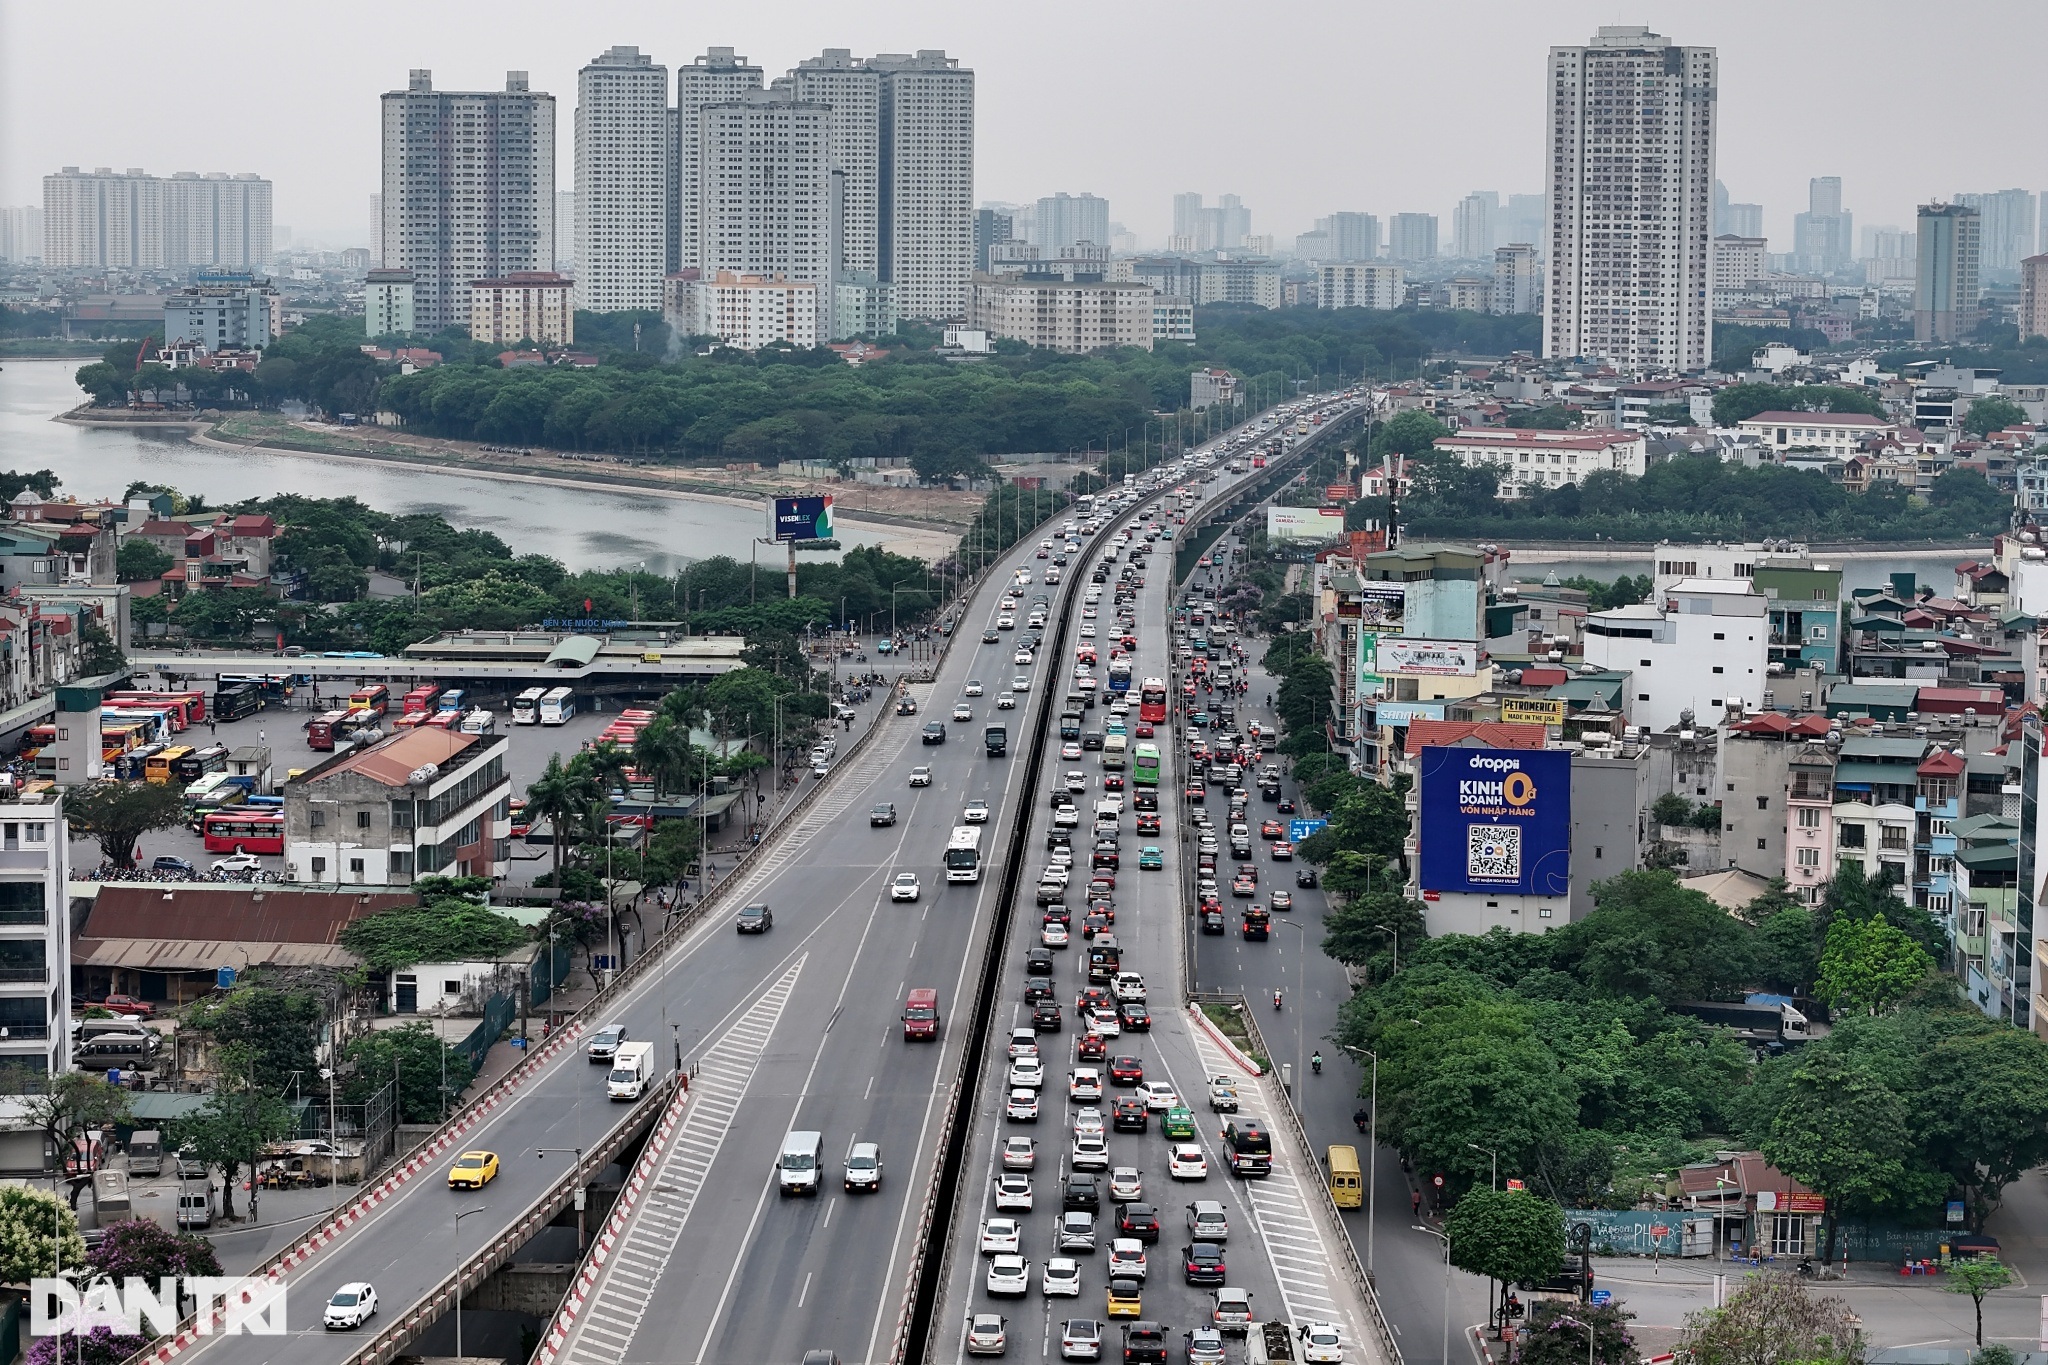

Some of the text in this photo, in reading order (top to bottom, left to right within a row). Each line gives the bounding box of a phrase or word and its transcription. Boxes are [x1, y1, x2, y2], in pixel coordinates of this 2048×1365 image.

[543, 616, 559, 627] BẾN
[561, 619, 573, 627] XE
[1504, 699, 1557, 713] PETROMERICA
[1470, 754, 1520, 773] droppii
[1460, 780, 1503, 796] KINH
[1460, 795, 1503, 806] DOANH
[1460, 804, 1536, 817] VỐN NHẬP HÀNG
